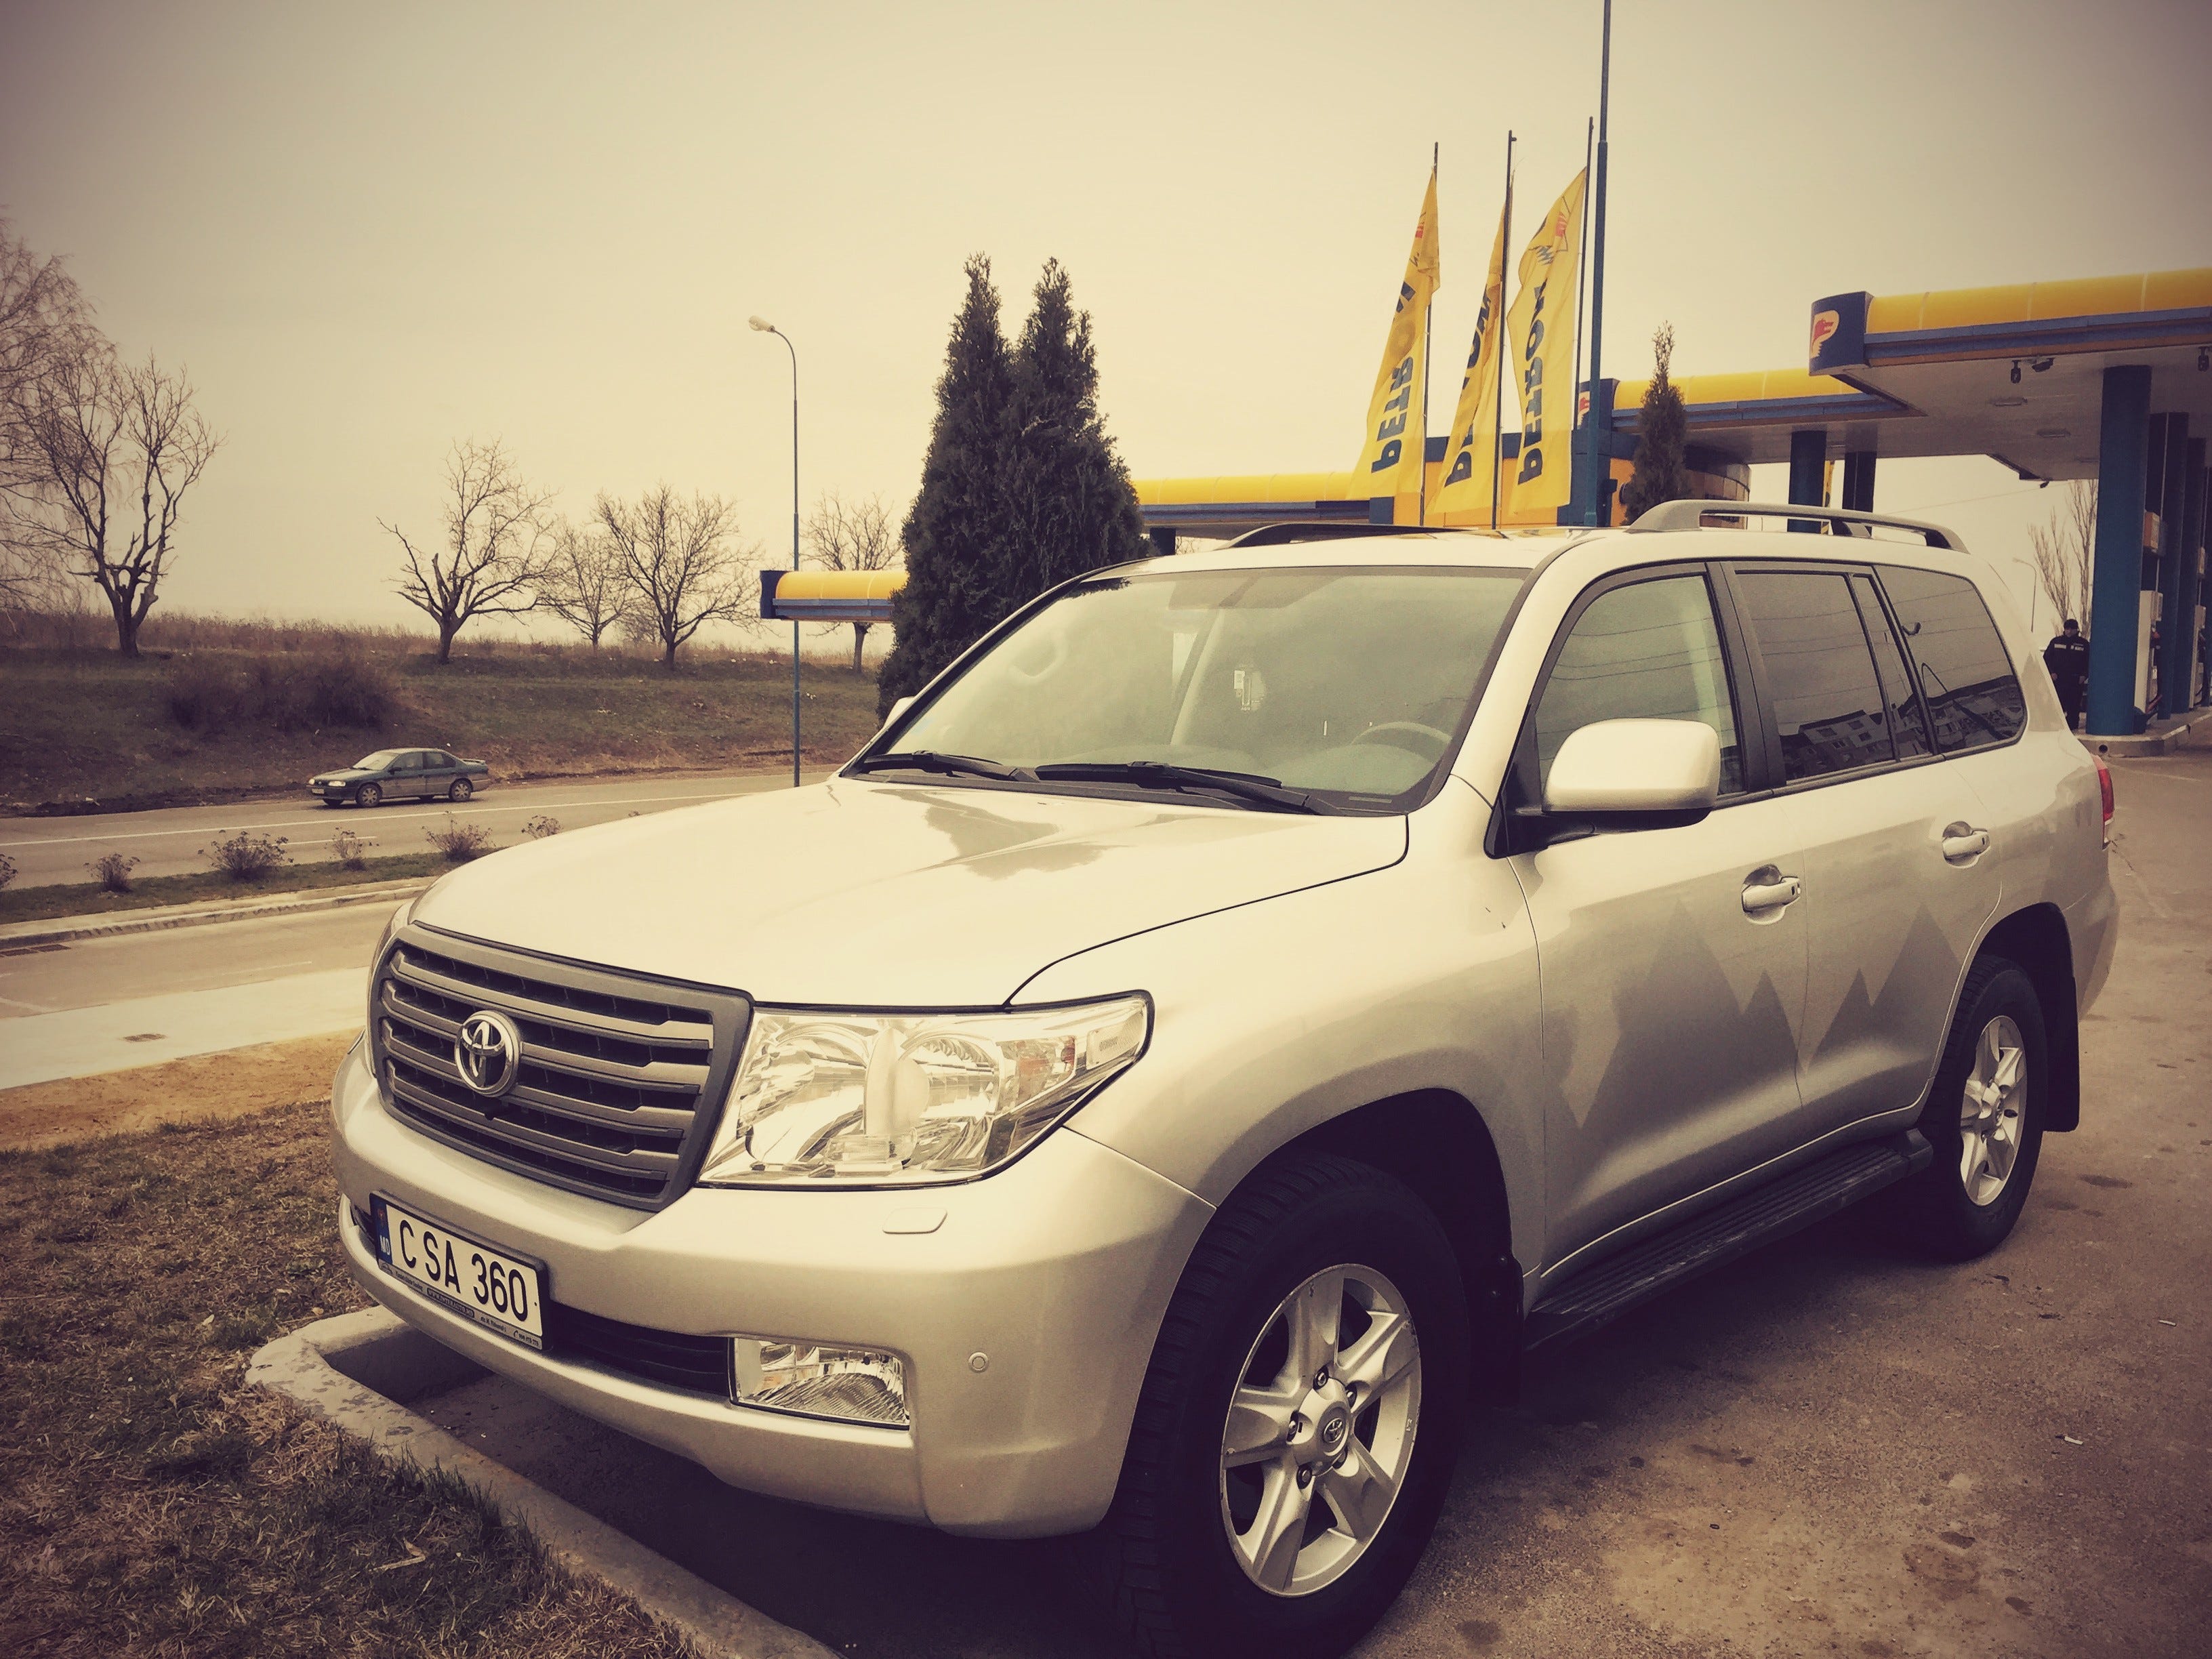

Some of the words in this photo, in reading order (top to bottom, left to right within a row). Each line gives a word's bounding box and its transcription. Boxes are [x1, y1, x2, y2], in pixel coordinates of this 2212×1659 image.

[380, 1235, 390, 1256] MD
[400, 1220, 416, 1268] C
[423, 1231, 461, 1294] SA
[472, 1253, 528, 1322] 360
